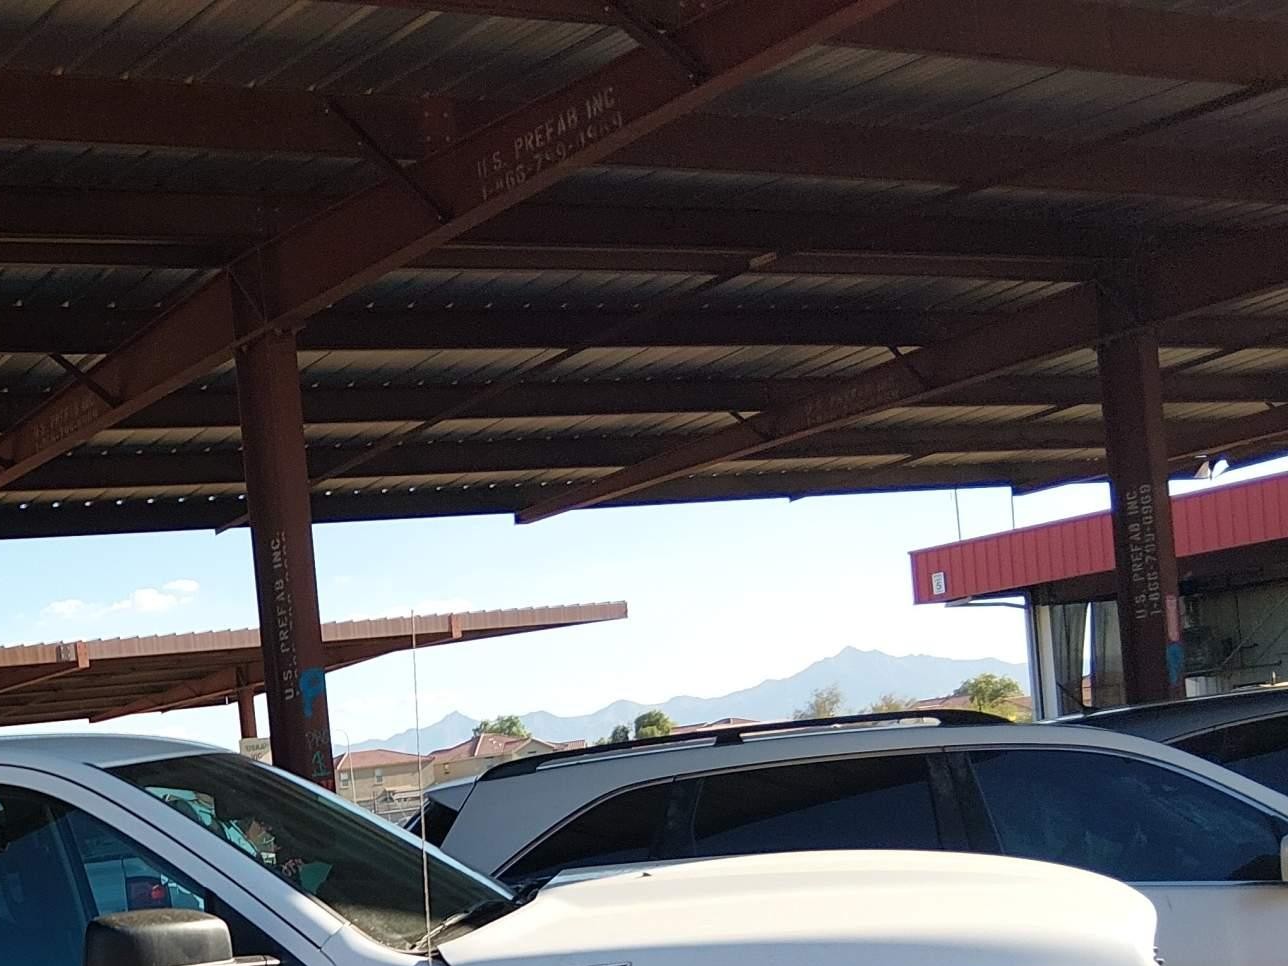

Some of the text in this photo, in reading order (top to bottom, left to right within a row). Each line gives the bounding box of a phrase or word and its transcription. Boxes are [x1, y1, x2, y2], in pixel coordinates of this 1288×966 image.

[513, 106, 579, 160] PREFAB
[1128, 523, 1146, 582] PREFAB
[275, 578, 291, 654] PREFAB
